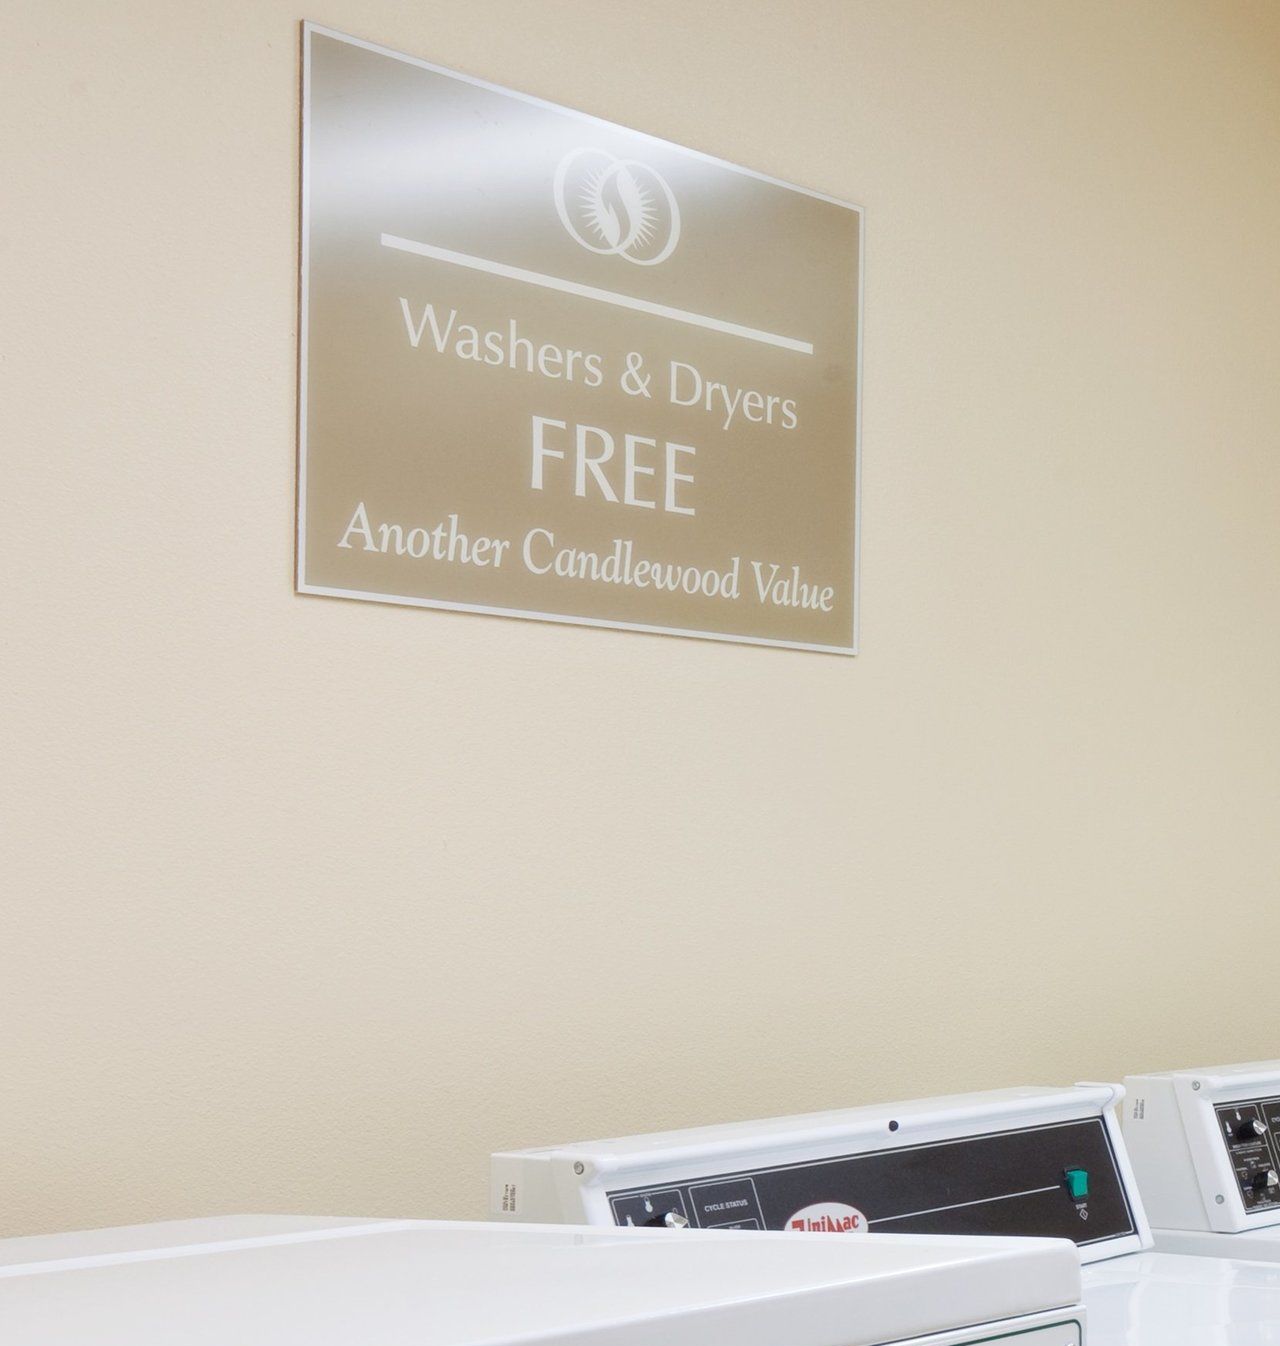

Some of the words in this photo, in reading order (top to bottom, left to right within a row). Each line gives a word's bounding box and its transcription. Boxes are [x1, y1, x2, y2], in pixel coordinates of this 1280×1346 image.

[399, 297, 602, 385] Washers
[621, 352, 652, 397] &
[670, 362, 797, 430] Dryers
[530, 416, 696, 516] FREE
[337, 502, 509, 567] Another
[522, 528, 739, 598] Candlewood
[750, 562, 834, 611] Value
[704, 1202, 724, 1213] CYCLE
[726, 1199, 748, 1209] STATUS
